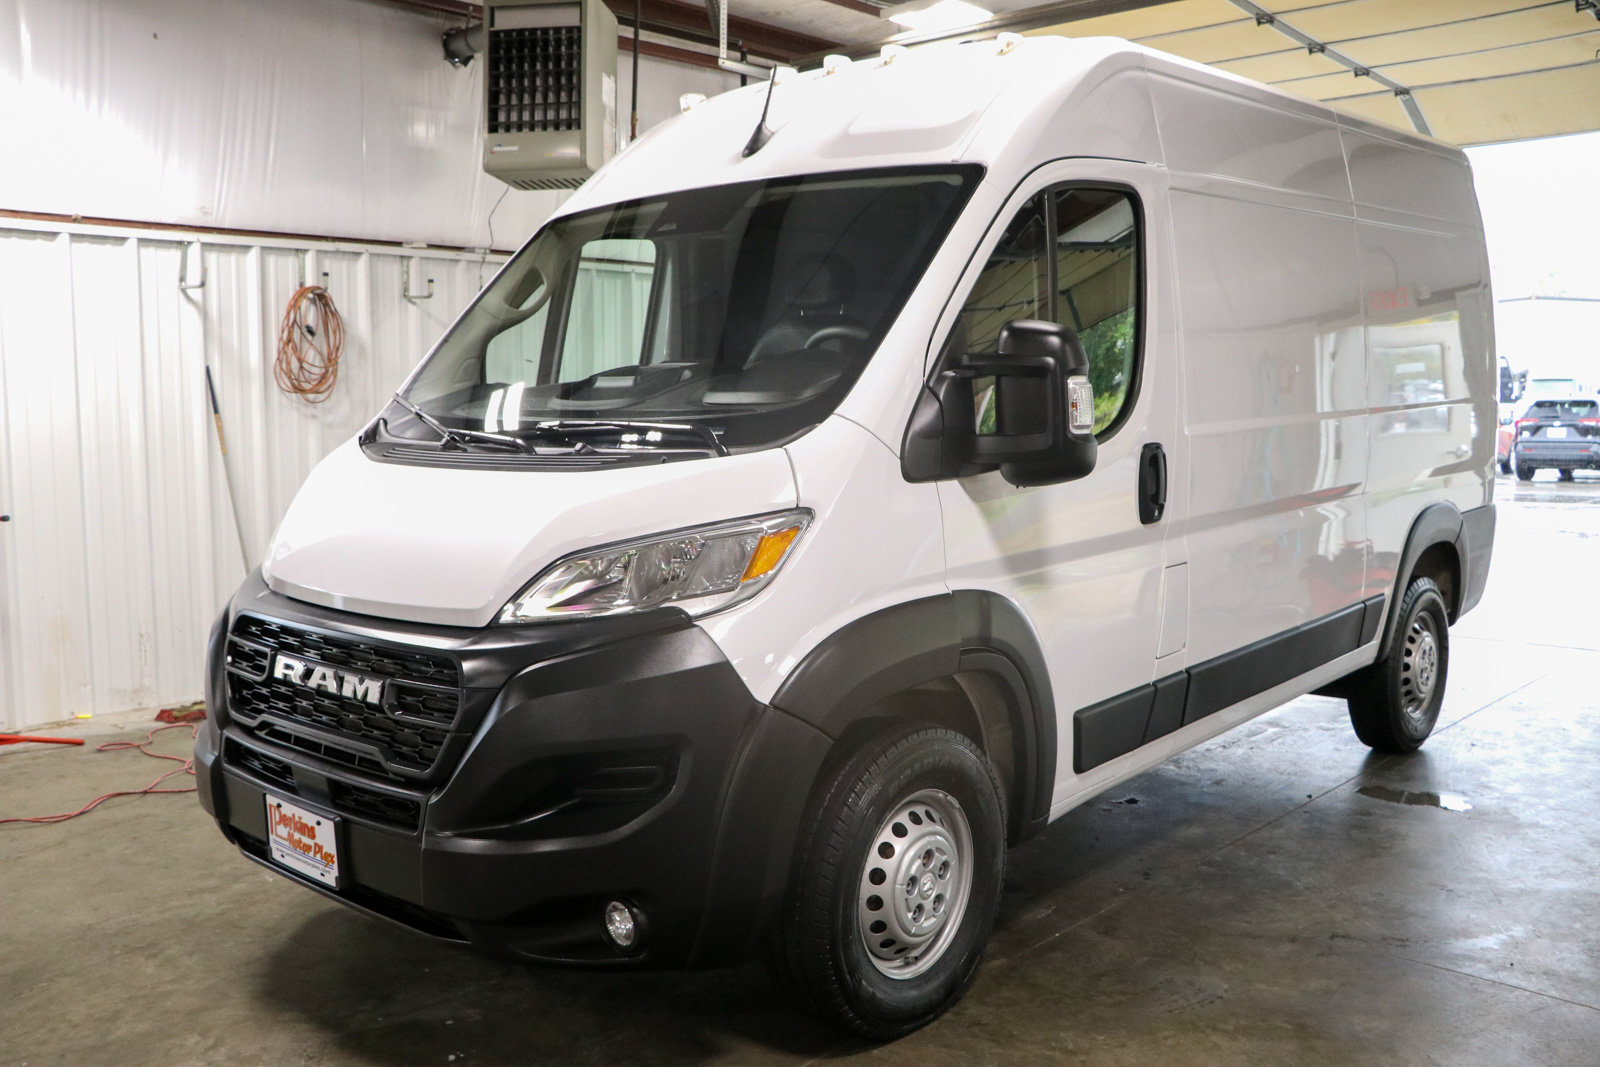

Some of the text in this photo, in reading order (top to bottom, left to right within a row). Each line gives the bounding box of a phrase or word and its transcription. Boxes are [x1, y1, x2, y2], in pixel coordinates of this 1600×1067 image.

[274, 655, 382, 704] RAM
[268, 804, 317, 840] Perkins
[287, 831, 336, 868] Motor Plex
